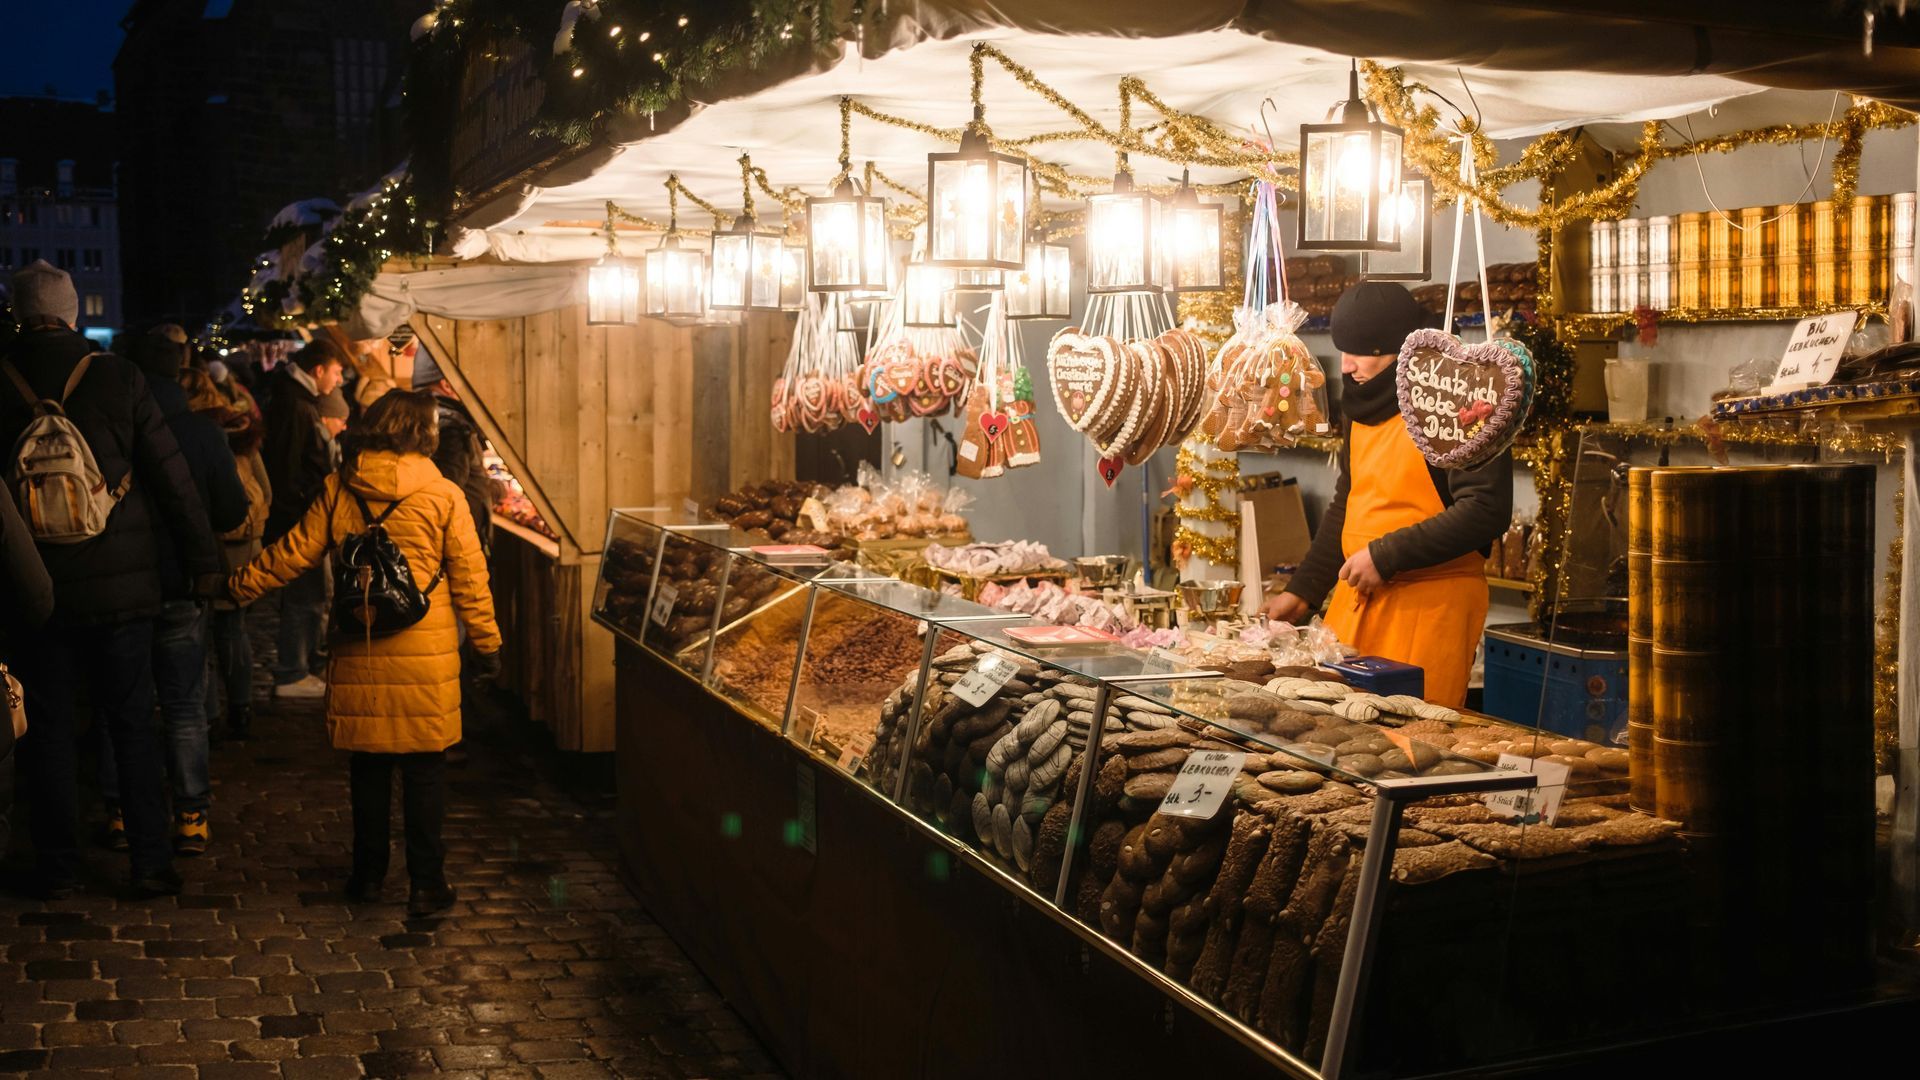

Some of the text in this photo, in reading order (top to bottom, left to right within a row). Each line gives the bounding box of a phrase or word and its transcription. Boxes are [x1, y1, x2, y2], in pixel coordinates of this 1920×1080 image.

[1788, 335, 1840, 353] LEBKUCHEN
[1473, 376, 1498, 406] ich
[1423, 414, 1468, 443] Dich
